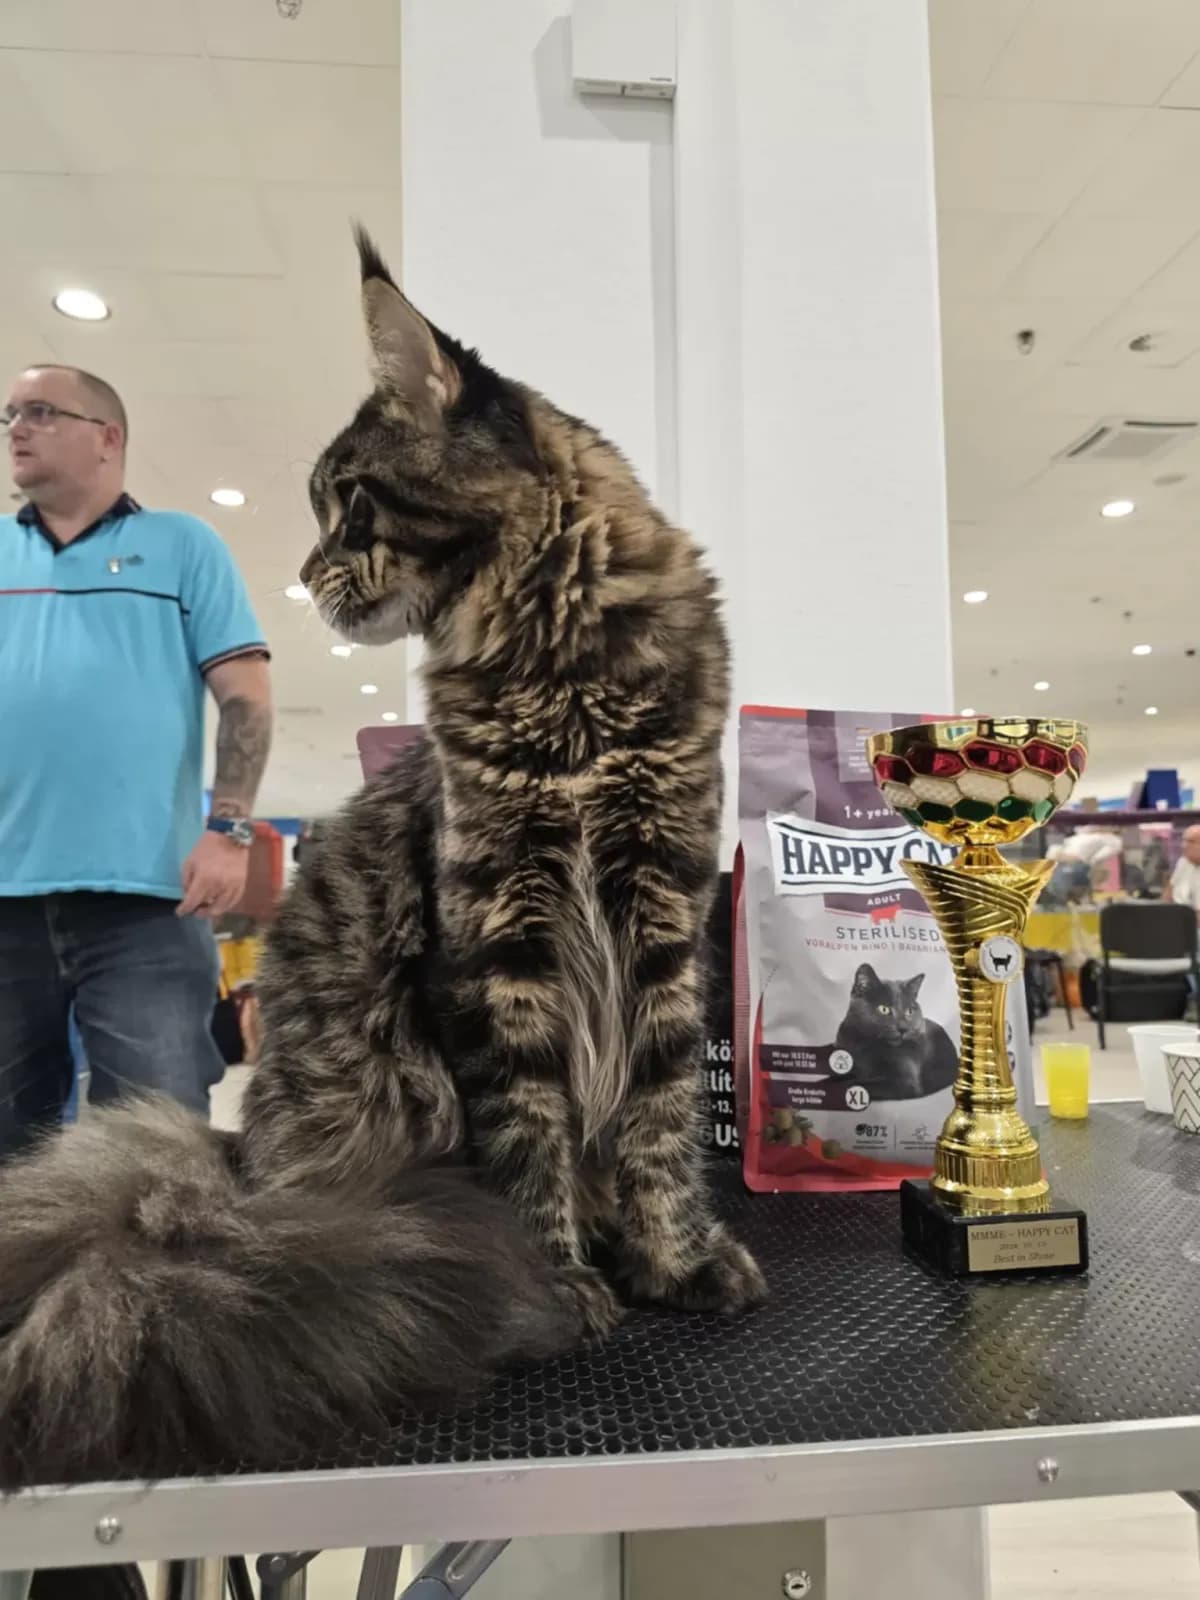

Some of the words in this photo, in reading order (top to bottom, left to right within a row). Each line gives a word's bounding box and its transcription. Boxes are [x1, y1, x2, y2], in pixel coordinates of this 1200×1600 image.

[779, 832, 896, 876] HAPPY
[867, 893, 901, 905] ADULT
[836, 926, 940, 941] STERILISED
[706, 1040, 734, 1062] kö
[711, 1068, 735, 1092] lít
[849, 1090, 867, 1105] XL
[1017, 1226, 1050, 1238] HAPPY
[1054, 1225, 1075, 1236] CAT
